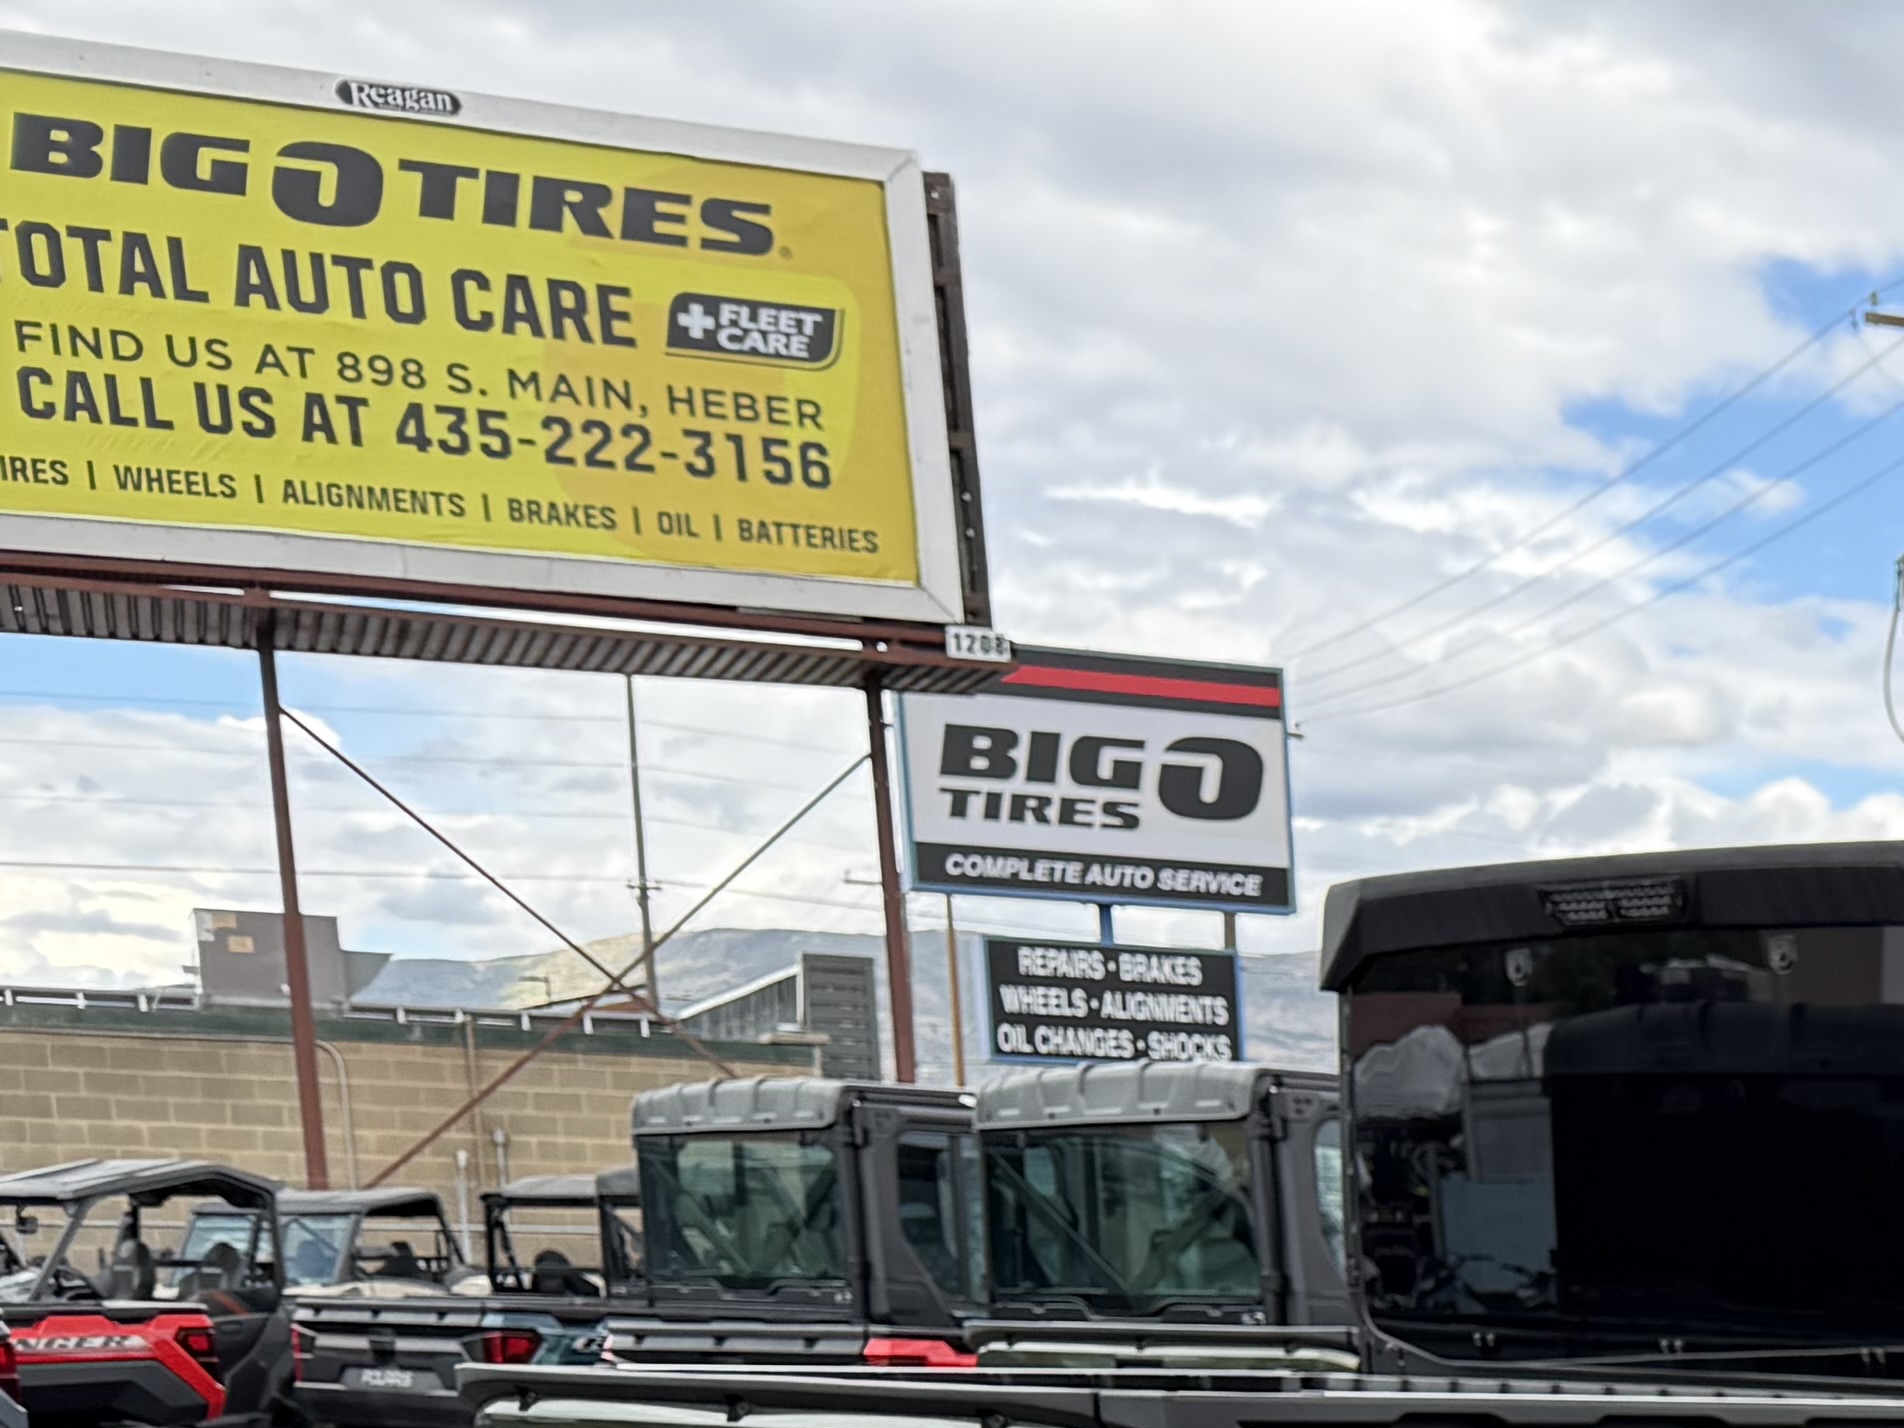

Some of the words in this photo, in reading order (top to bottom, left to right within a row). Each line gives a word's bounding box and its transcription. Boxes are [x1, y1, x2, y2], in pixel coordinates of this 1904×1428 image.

[349, 81, 453, 113] Reagan
[9, 111, 251, 197] BIG
[271, 140, 385, 228] O
[397, 157, 775, 257] TIRES
[0, 218, 210, 304] OTAL
[234, 243, 427, 326] AUTO
[451, 268, 638, 349] CARE
[718, 302, 824, 337] FLEET
[715, 326, 811, 359] CARE
[13, 319, 145, 363] FIND
[164, 333, 233, 372] US
[254, 343, 316, 379] AT
[336, 350, 428, 391] 898
[446, 362, 488, 398] S.
[506, 367, 650, 419] MAIN,
[666, 383, 825, 432] HEBER
[15, 365, 176, 431] CALL
[193, 380, 277, 439] US
[300, 391, 371, 448] AT
[395, 401, 833, 490] 435-222-3156
[111, 463, 238, 499] WHEELS
[281, 478, 467, 517] ALIGNMENTS
[507, 497, 618, 532] BRAKES
[657, 510, 700, 538] OIL
[737, 518, 880, 554] BATTERIES
[940, 723, 1146, 791] BIG
[1158, 736, 1264, 821] O
[939, 786, 1140, 830] TIRES
[945, 853, 1083, 885] COMPLETE
[1084, 863, 1155, 890] AUTO
[1156, 867, 1264, 897] SERVICE
[1017, 946, 1106, 981] REPAIRS
[1118, 952, 1204, 987] BRAKES
[998, 984, 1089, 1018] WHEELS
[1100, 990, 1230, 1026] ALIGNMENTS
[997, 1022, 1035, 1053] OIL
[1034, 1025, 1135, 1059] CHANGES
[1147, 1031, 1233, 1061] SHOCKS
